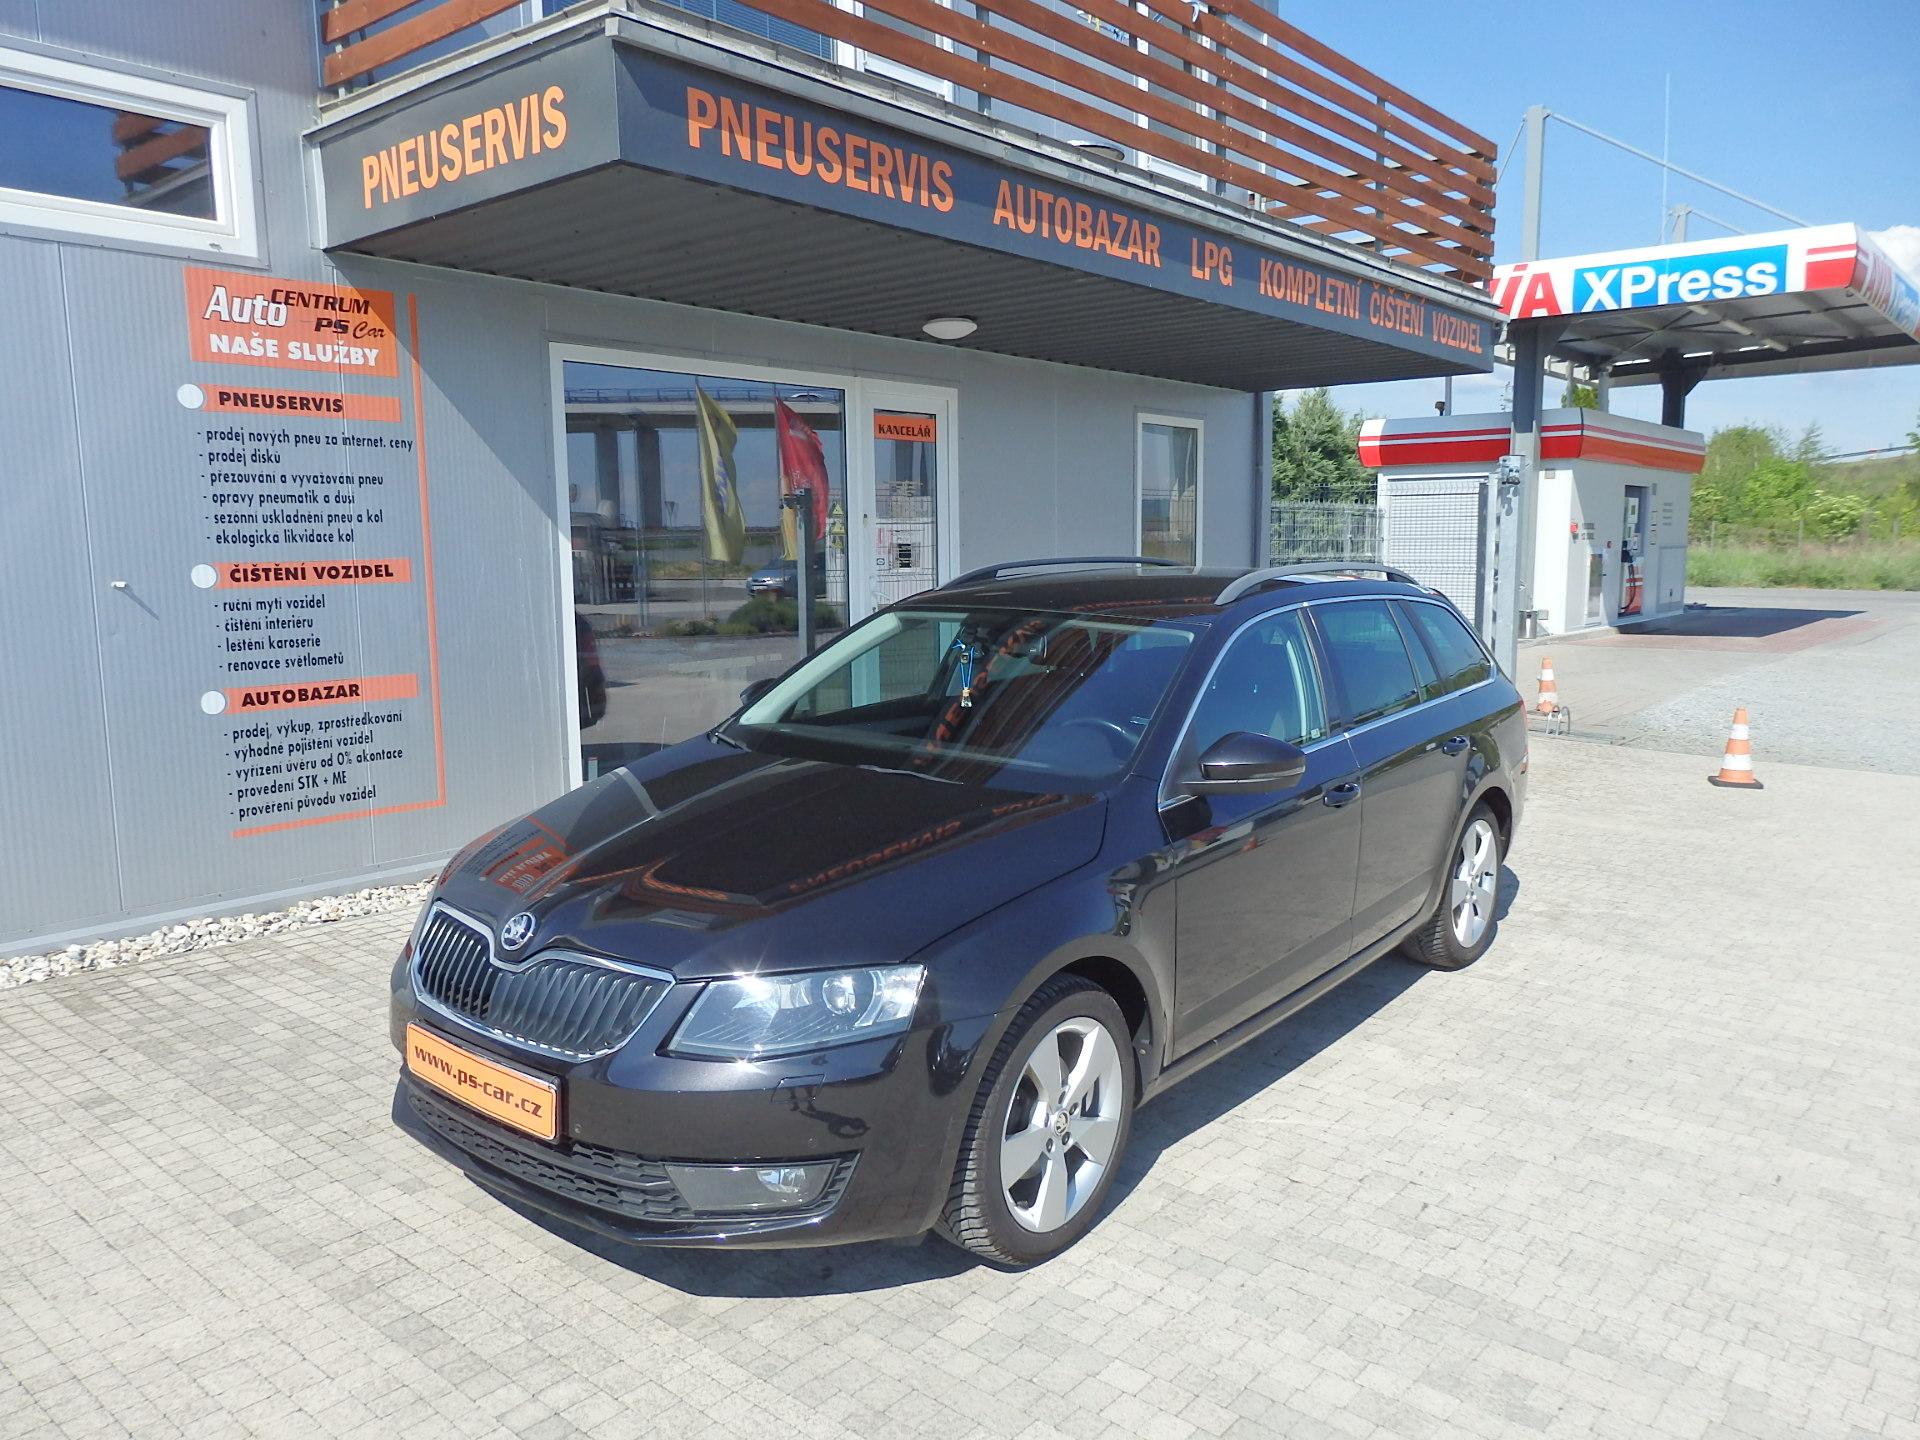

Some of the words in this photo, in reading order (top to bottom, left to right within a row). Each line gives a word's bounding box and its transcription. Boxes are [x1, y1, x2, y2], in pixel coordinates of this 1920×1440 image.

[362, 85, 567, 209] PNEUSERVIS
[686, 86, 954, 214] PNEUSERVIS
[993, 179, 1162, 268] AUTOBAZAR
[1191, 237, 1233, 287] LPG
[1259, 257, 1363, 320] KOMPLETNÍ
[1369, 281, 1426, 337] ČIŠTĚNÍ
[1432, 310, 1483, 354] VOZIDEL
[203, 284, 288, 327] Auto
[271, 288, 370, 315] CENTRUM
[314, 317, 349, 334] PS
[353, 321, 385, 339] Car
[209, 331, 279, 358] NAŠE
[288, 340, 379, 367] SLUŽBY
[218, 391, 343, 413] PNEUSERVIS
[206, 426, 245, 445] prodej
[248, 428, 290, 446] nových
[294, 434, 320, 447] pneu
[325, 435, 338, 445] za
[390, 438, 413, 452] ceny
[208, 447, 246, 467] prodej
[280, 474, 286, 483] a
[358, 477, 383, 488] pneu
[212, 493, 254, 507] opravy
[259, 490, 319, 507] pneumatik
[323, 494, 330, 503] a
[327, 513, 352, 527] pneu
[357, 514, 363, 523] a
[366, 509, 383, 523] kol
[284, 528, 334, 543] likvidace
[338, 528, 354, 542] kol
[230, 563, 307, 583] ČIŠTĚNÍ
[313, 564, 394, 580] VOZIDEL
[286, 594, 326, 609] vozidel
[268, 633, 321, 650] karoserie
[228, 659, 281, 672] renovace
[241, 683, 360, 708] AUTOBAZAR
[233, 722, 272, 743] prodej,
[336, 730, 373, 747] vozidel
[321, 753, 333, 768] od
[337, 751, 352, 765] 0%
[356, 749, 403, 763] akontace
[298, 774, 319, 790] STK
[332, 771, 347, 785] ME
[340, 785, 377, 802] vozidel
[414, 1045, 543, 1119] www.ps-car.cz
